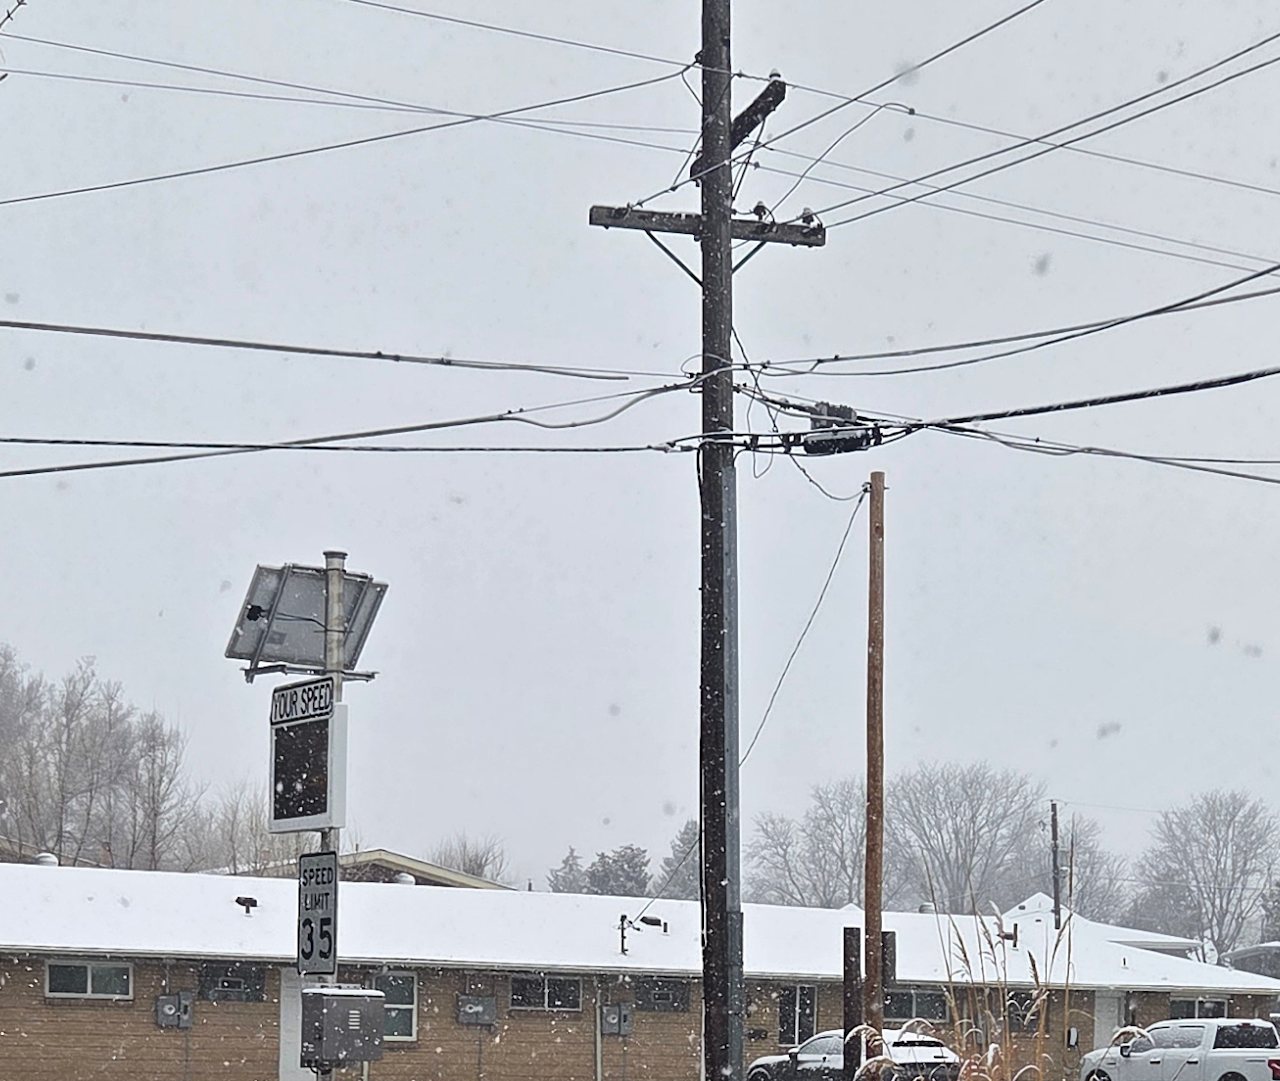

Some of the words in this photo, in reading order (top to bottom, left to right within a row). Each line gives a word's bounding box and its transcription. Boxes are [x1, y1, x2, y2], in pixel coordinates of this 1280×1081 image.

[273, 690, 298, 720] YOUR
[300, 683, 331, 715] SPEED
[302, 867, 334, 887] SPEED
[304, 892, 330, 911] LIMIT
[300, 917, 333, 960] 35
